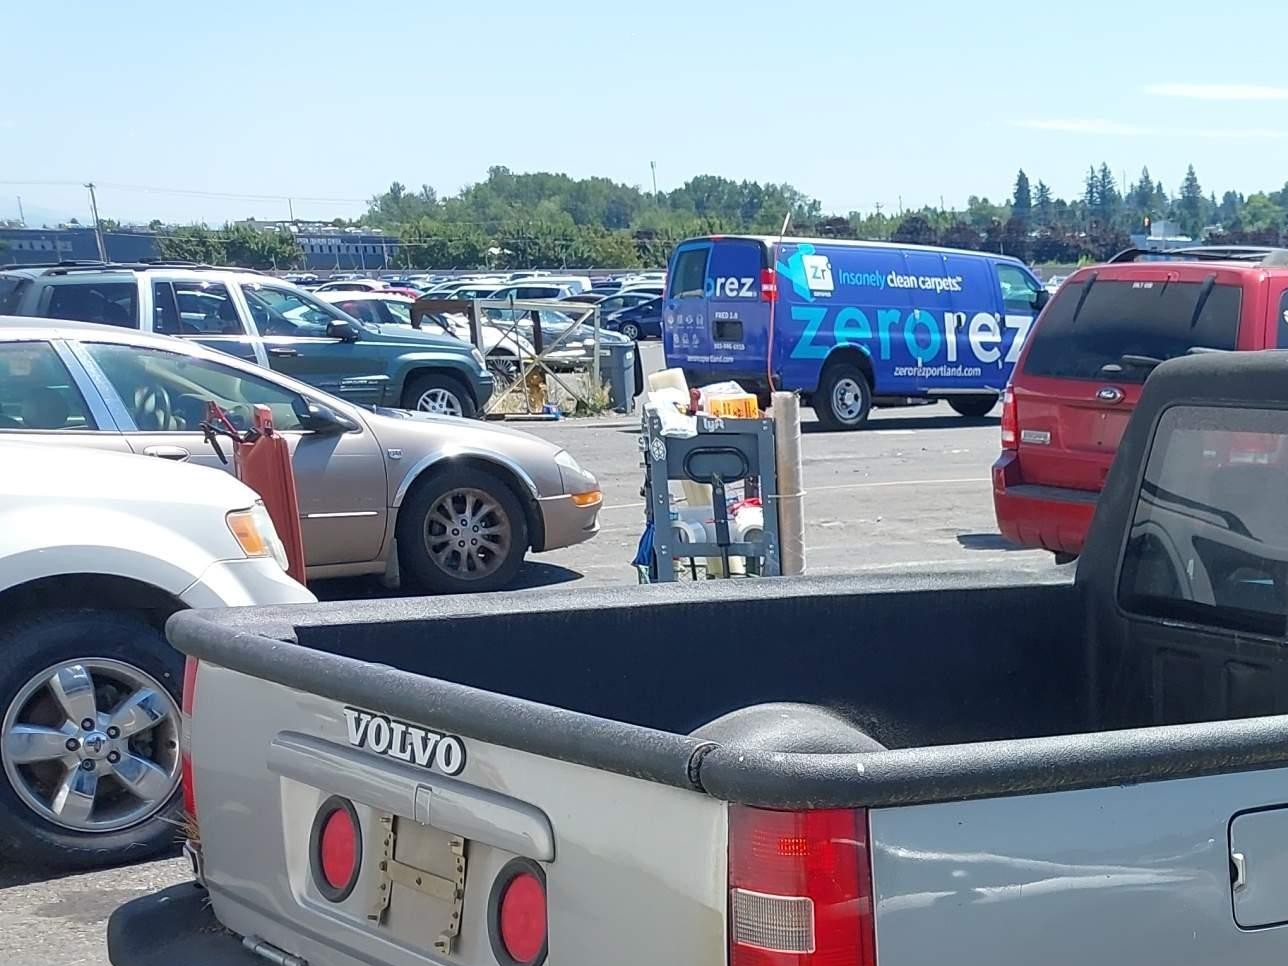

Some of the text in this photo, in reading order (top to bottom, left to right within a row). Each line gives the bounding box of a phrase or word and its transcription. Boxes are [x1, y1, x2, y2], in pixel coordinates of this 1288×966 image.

[810, 265, 827, 280] Zr
[838, 269, 885, 290] Insanely
[886, 271, 918, 289] clean
[790, 306, 1034, 364] zerorez
[893, 365, 981, 377] zerorezportland.com
[343, 706, 466, 776] VOLVO
